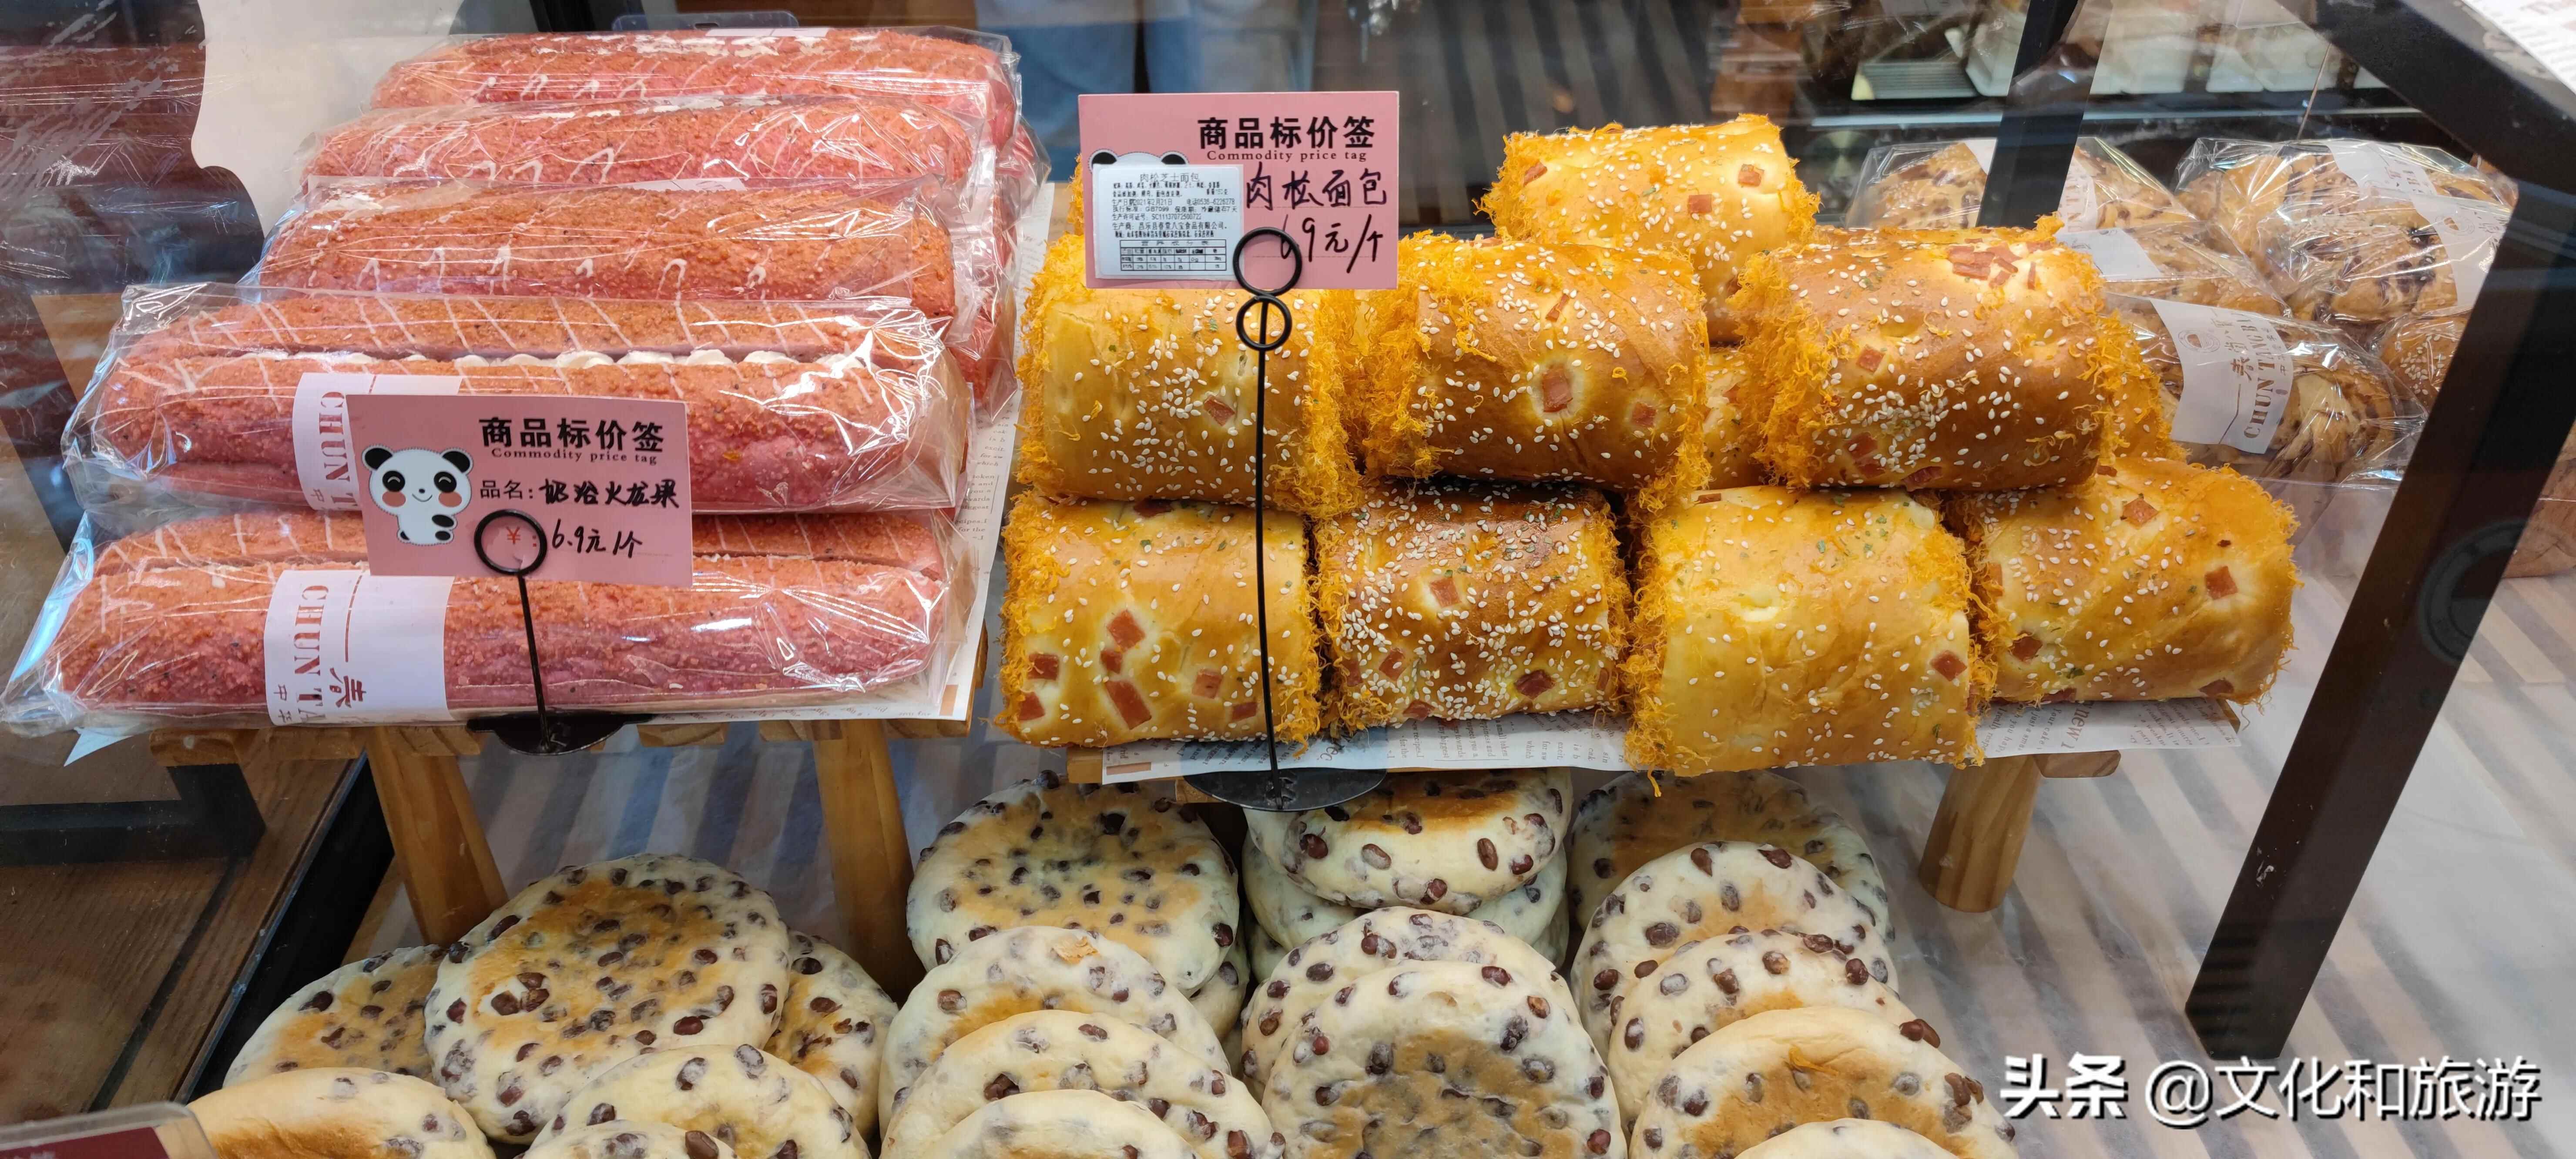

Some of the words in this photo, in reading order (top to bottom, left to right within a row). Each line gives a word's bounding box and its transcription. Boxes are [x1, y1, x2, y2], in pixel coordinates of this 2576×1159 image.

[1198, 116, 1375, 149] 商品标价签
[1207, 150, 1292, 163] Commodity
[1300, 151, 1337, 163] price
[1345, 152, 1366, 162] tag
[2244, 377, 2275, 439] CHUN
[319, 392, 350, 482] CHUN
[479, 415, 664, 452] 商品标价签
[491, 447, 583, 462] Commodity
[590, 452, 628, 462] price
[635, 454, 657, 465] tag
[293, 584, 329, 677] CHUN
